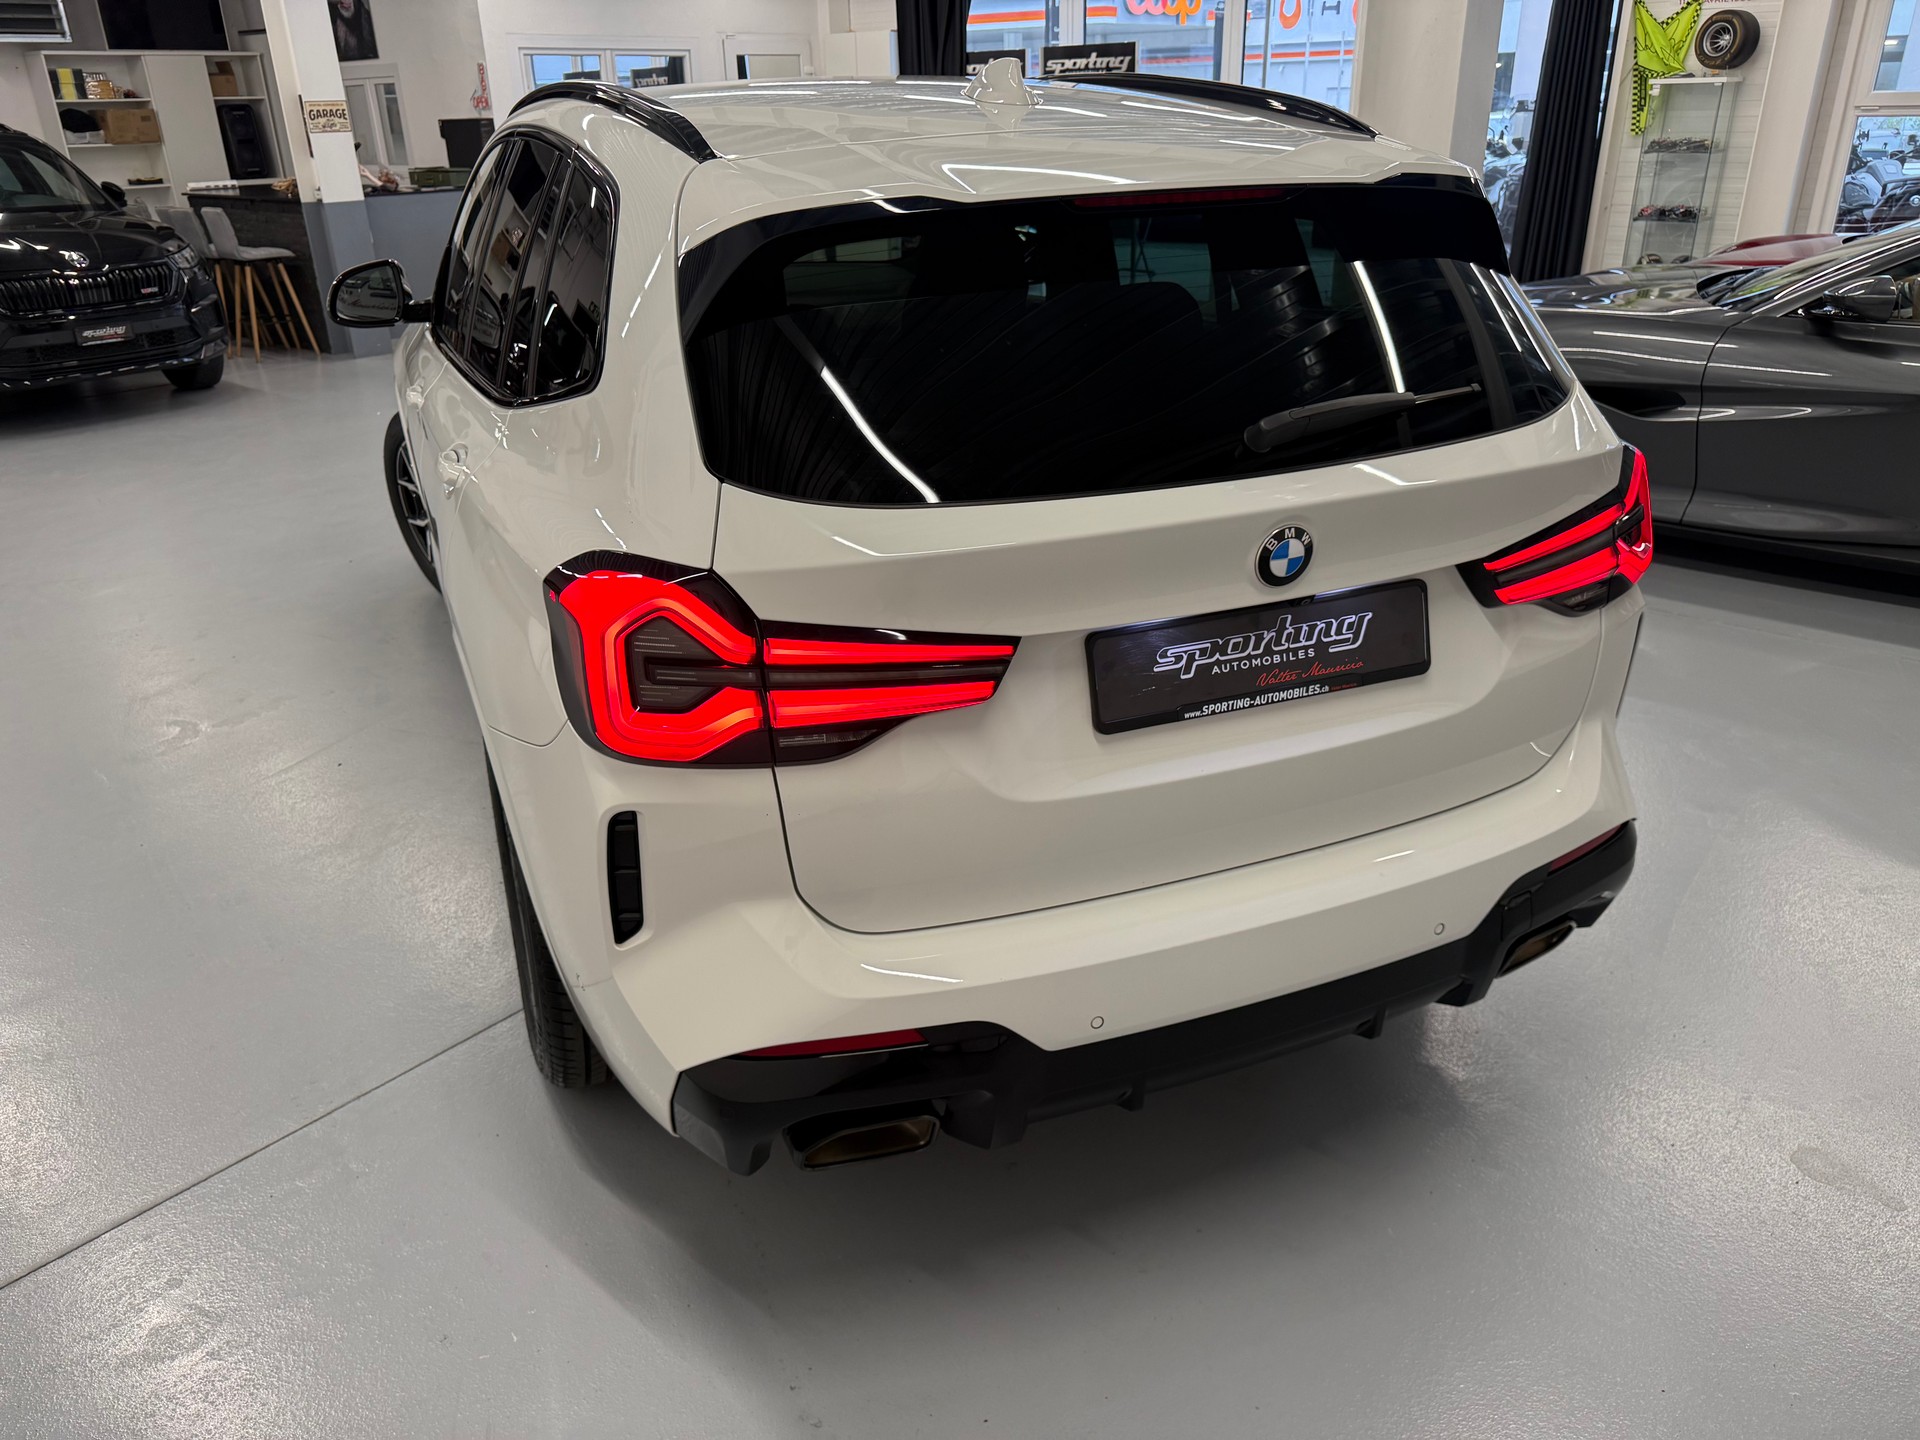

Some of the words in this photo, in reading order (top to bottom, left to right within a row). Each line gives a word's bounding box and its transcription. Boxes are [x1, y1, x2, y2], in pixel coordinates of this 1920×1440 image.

[308, 108, 348, 121] GARAGE
[1266, 528, 1311, 551] BMW
[1153, 611, 1373, 679] sporting
[1211, 648, 1316, 675] AUTOMOBILES
[1302, 657, 1364, 679] Mauricio
[1184, 684, 1330, 719] www.SPORTING-AUTOMOBILES.ch
